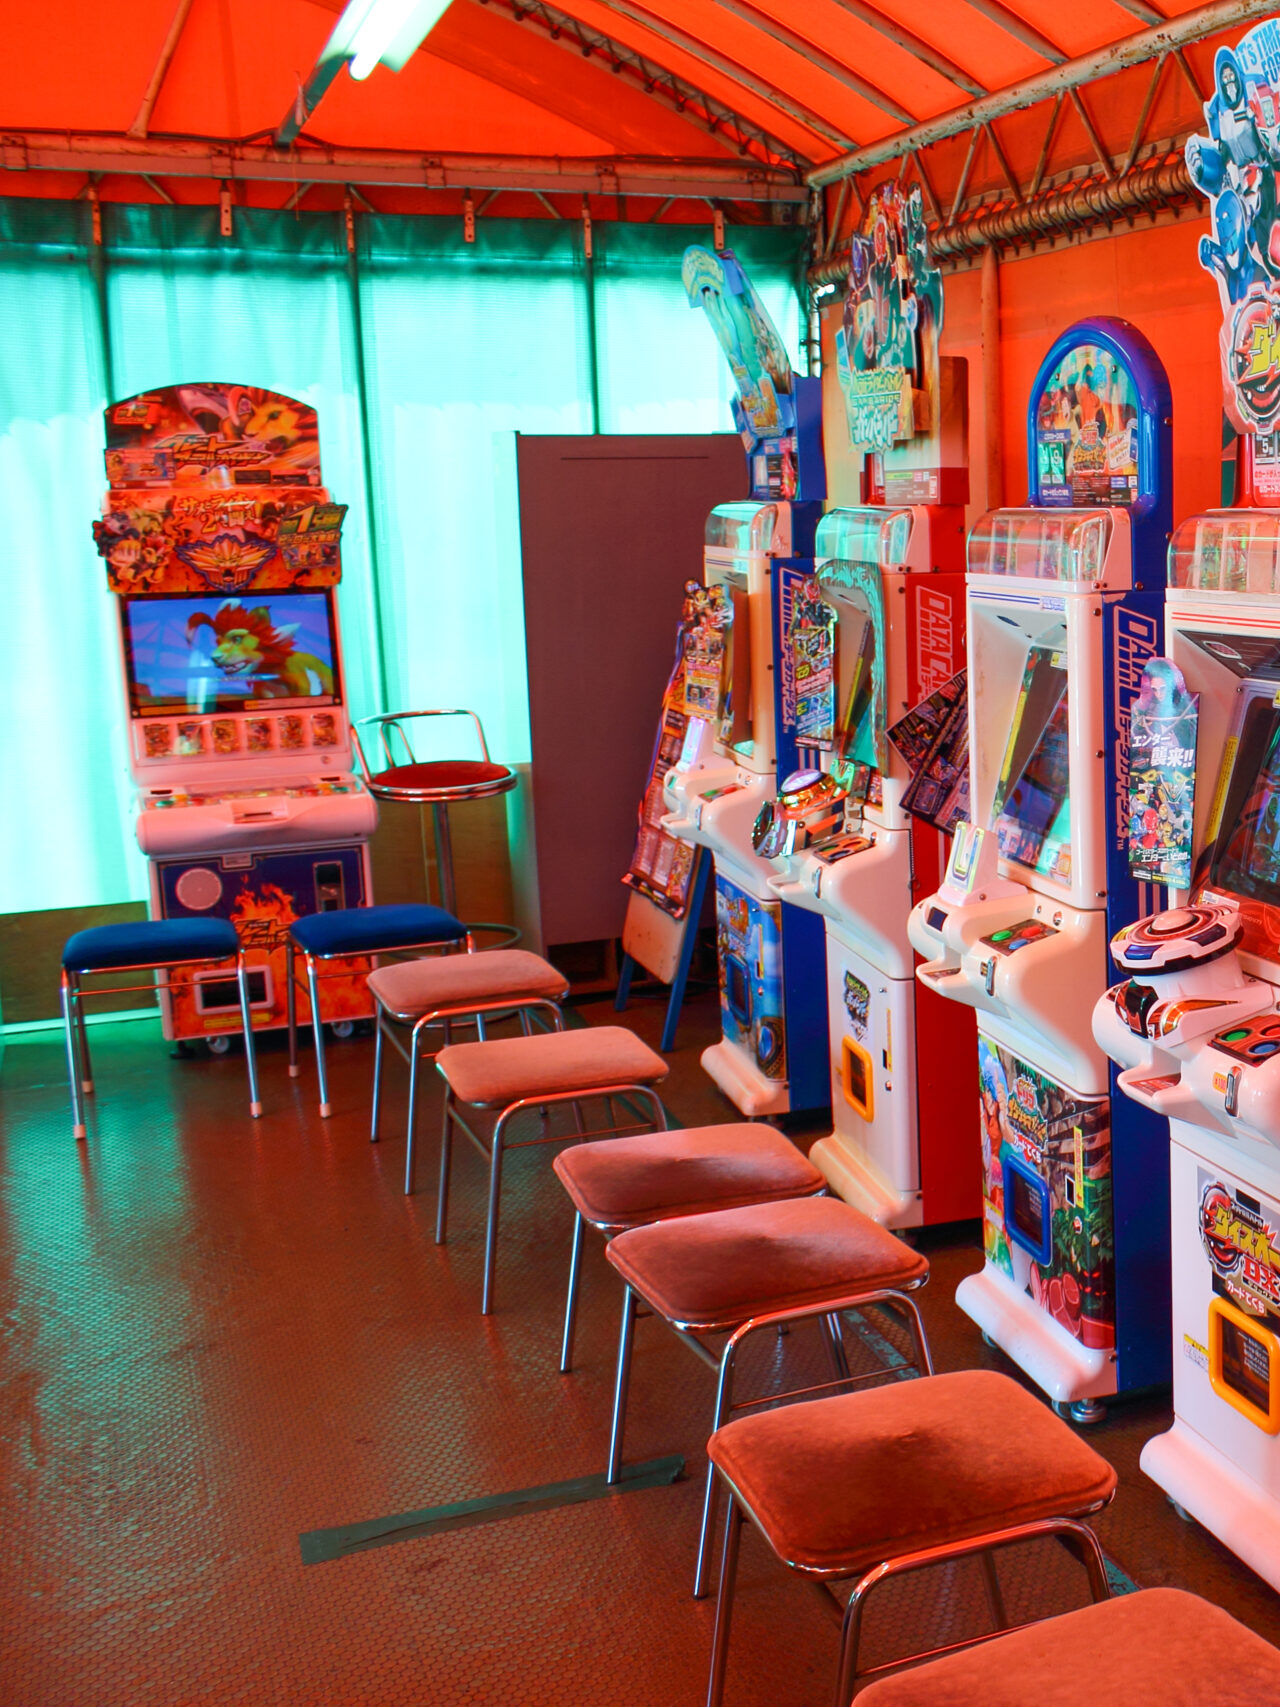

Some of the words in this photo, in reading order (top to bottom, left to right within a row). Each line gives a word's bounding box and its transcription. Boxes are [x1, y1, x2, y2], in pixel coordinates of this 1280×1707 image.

[1132, 734, 1172, 748] エンター
[1243, 1256, 1280, 1298] DX
